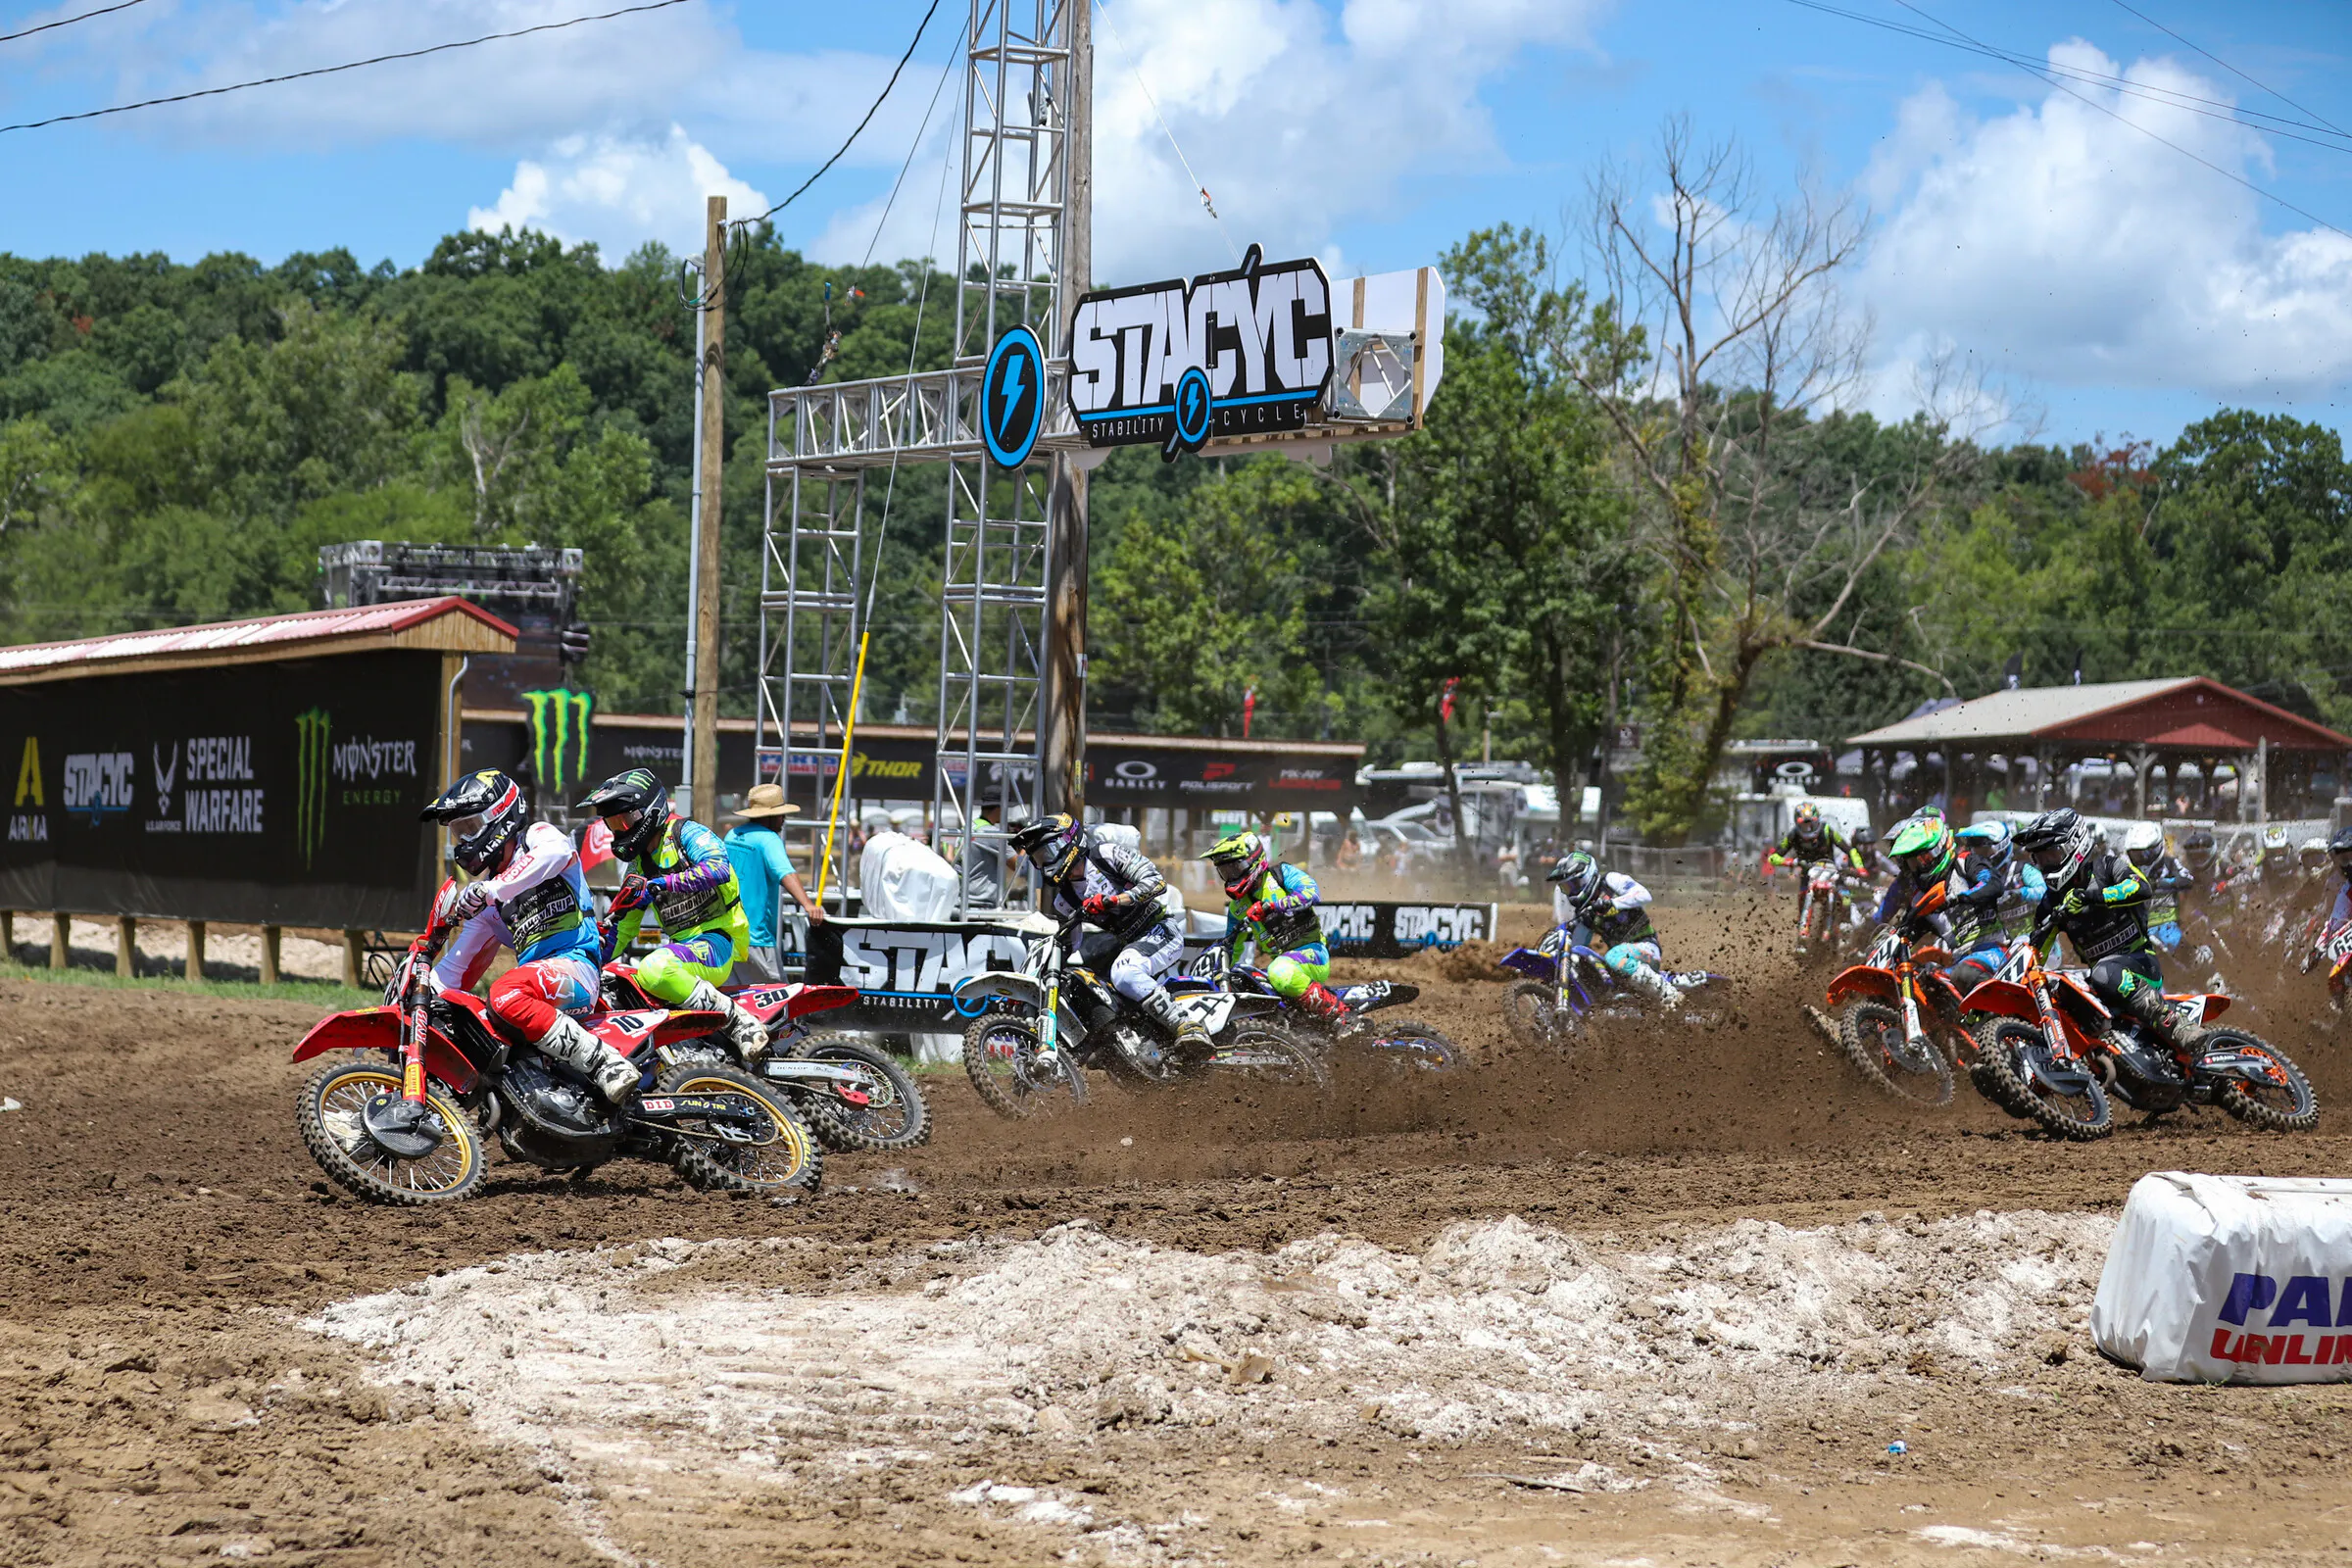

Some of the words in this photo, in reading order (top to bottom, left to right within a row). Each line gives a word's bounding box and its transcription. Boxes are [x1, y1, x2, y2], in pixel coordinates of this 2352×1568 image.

[1070, 268, 1328, 411] STACYC
[1092, 416, 1165, 439] STABILITY
[1222, 403, 1303, 426] CYCLE
[186, 735, 254, 781] SPECIAL
[333, 735, 416, 781] MONSTER
[623, 744, 684, 760] MONSTE
[63, 752, 134, 807] STACYC
[867, 760, 923, 777] THOR
[1104, 778, 1167, 790] OAKLEY
[184, 788, 264, 832] WARFARE
[342, 788, 401, 805] ENERGY
[8, 814, 48, 842] ARMA
[479, 820, 515, 862] ARMA
[502, 854, 534, 882] MOTUL
[1316, 906, 1376, 938] TACYC
[1394, 906, 1484, 941] STACYC
[1117, 957, 1131, 969] FLY
[754, 989, 789, 1008] 30
[862, 997, 940, 1009] STABILITY
[415, 1009, 428, 1047] KYB
[610, 1015, 645, 1033] 10
[794, 1121, 811, 1168] PIRELLI
